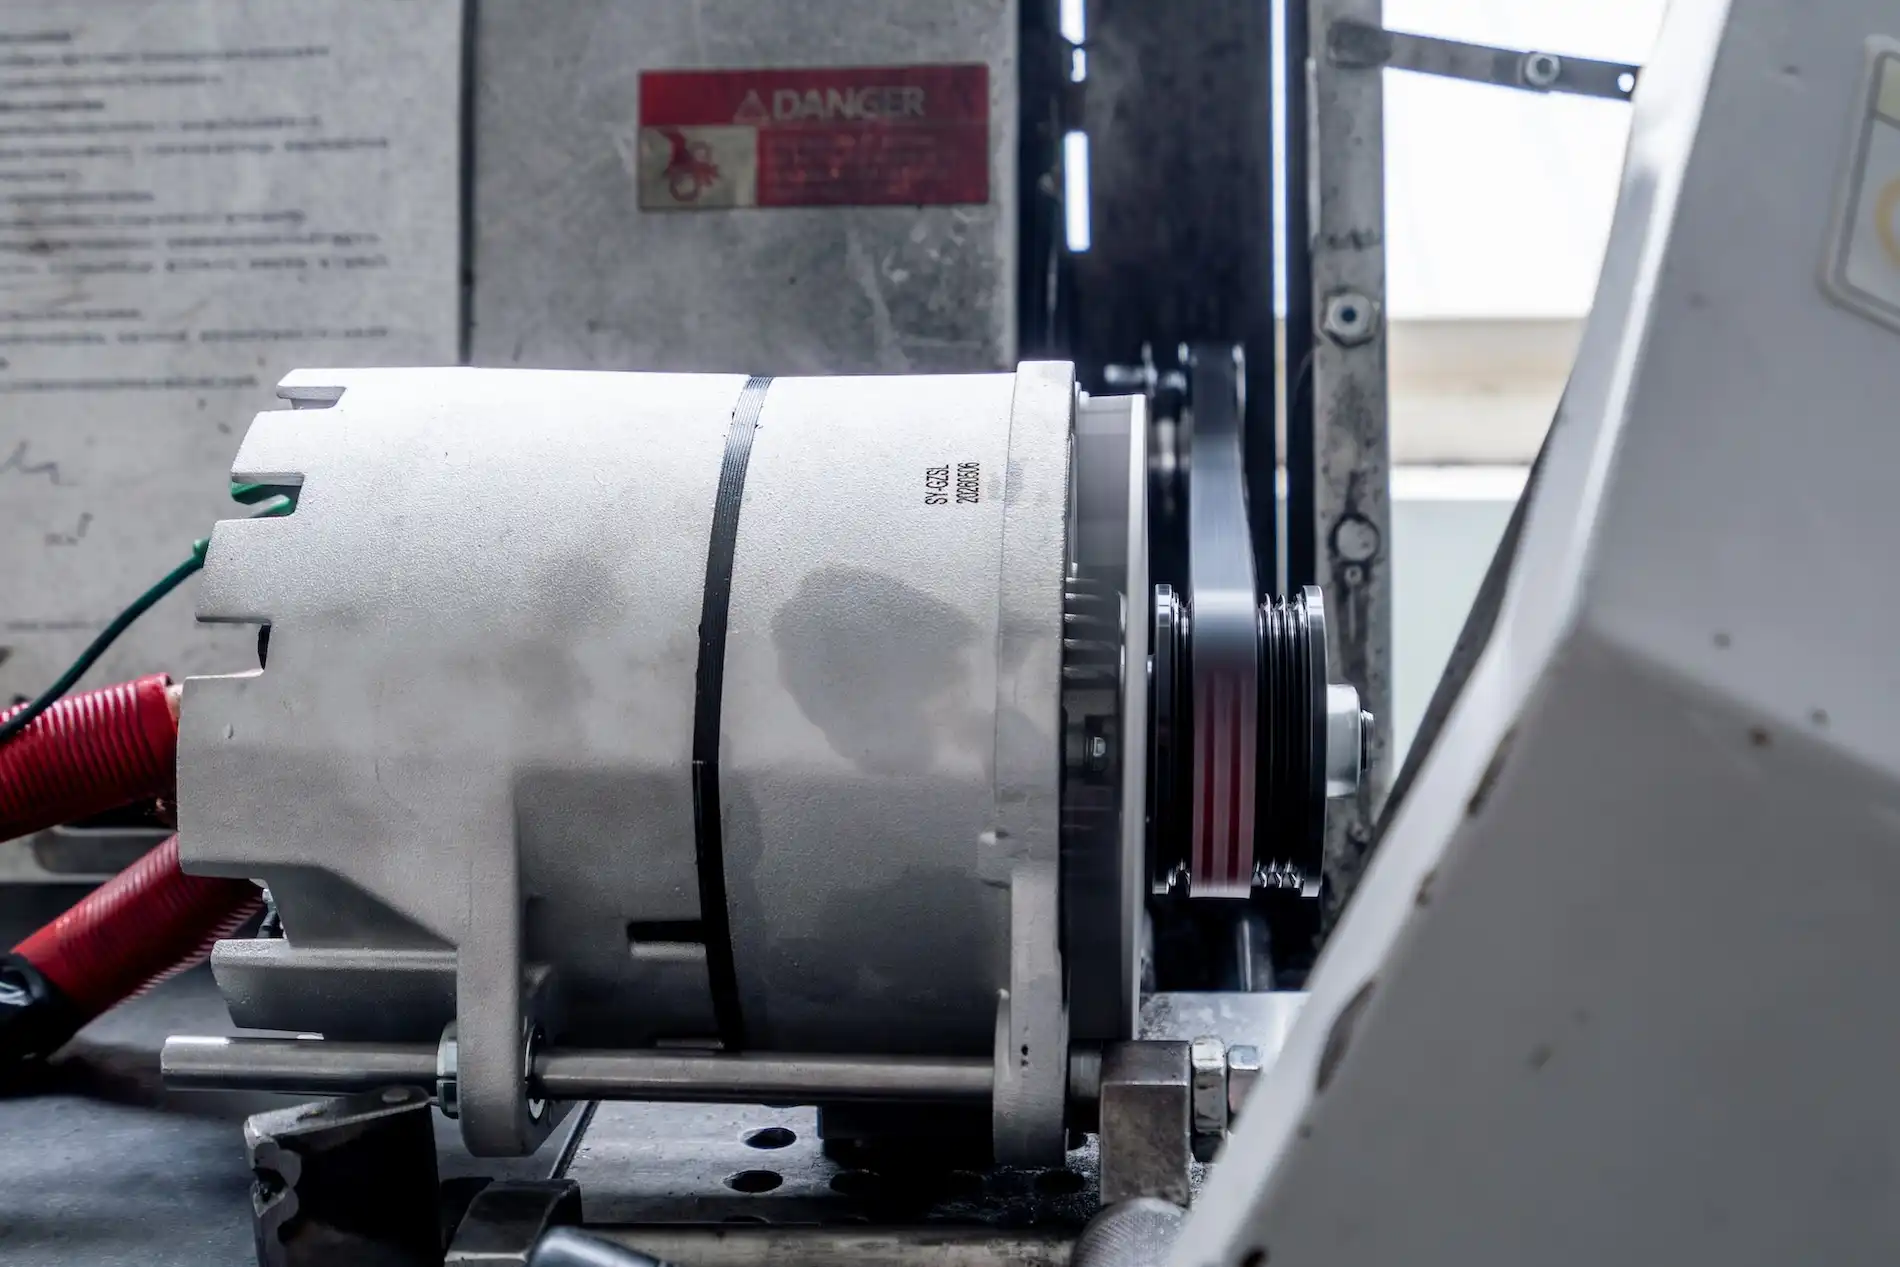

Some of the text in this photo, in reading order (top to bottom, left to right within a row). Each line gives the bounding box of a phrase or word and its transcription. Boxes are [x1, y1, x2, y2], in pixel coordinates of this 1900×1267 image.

[772, 86, 926, 120] DANGER
[924, 464, 949, 505] SY-GZSL
[956, 462, 980, 504] 20260506
